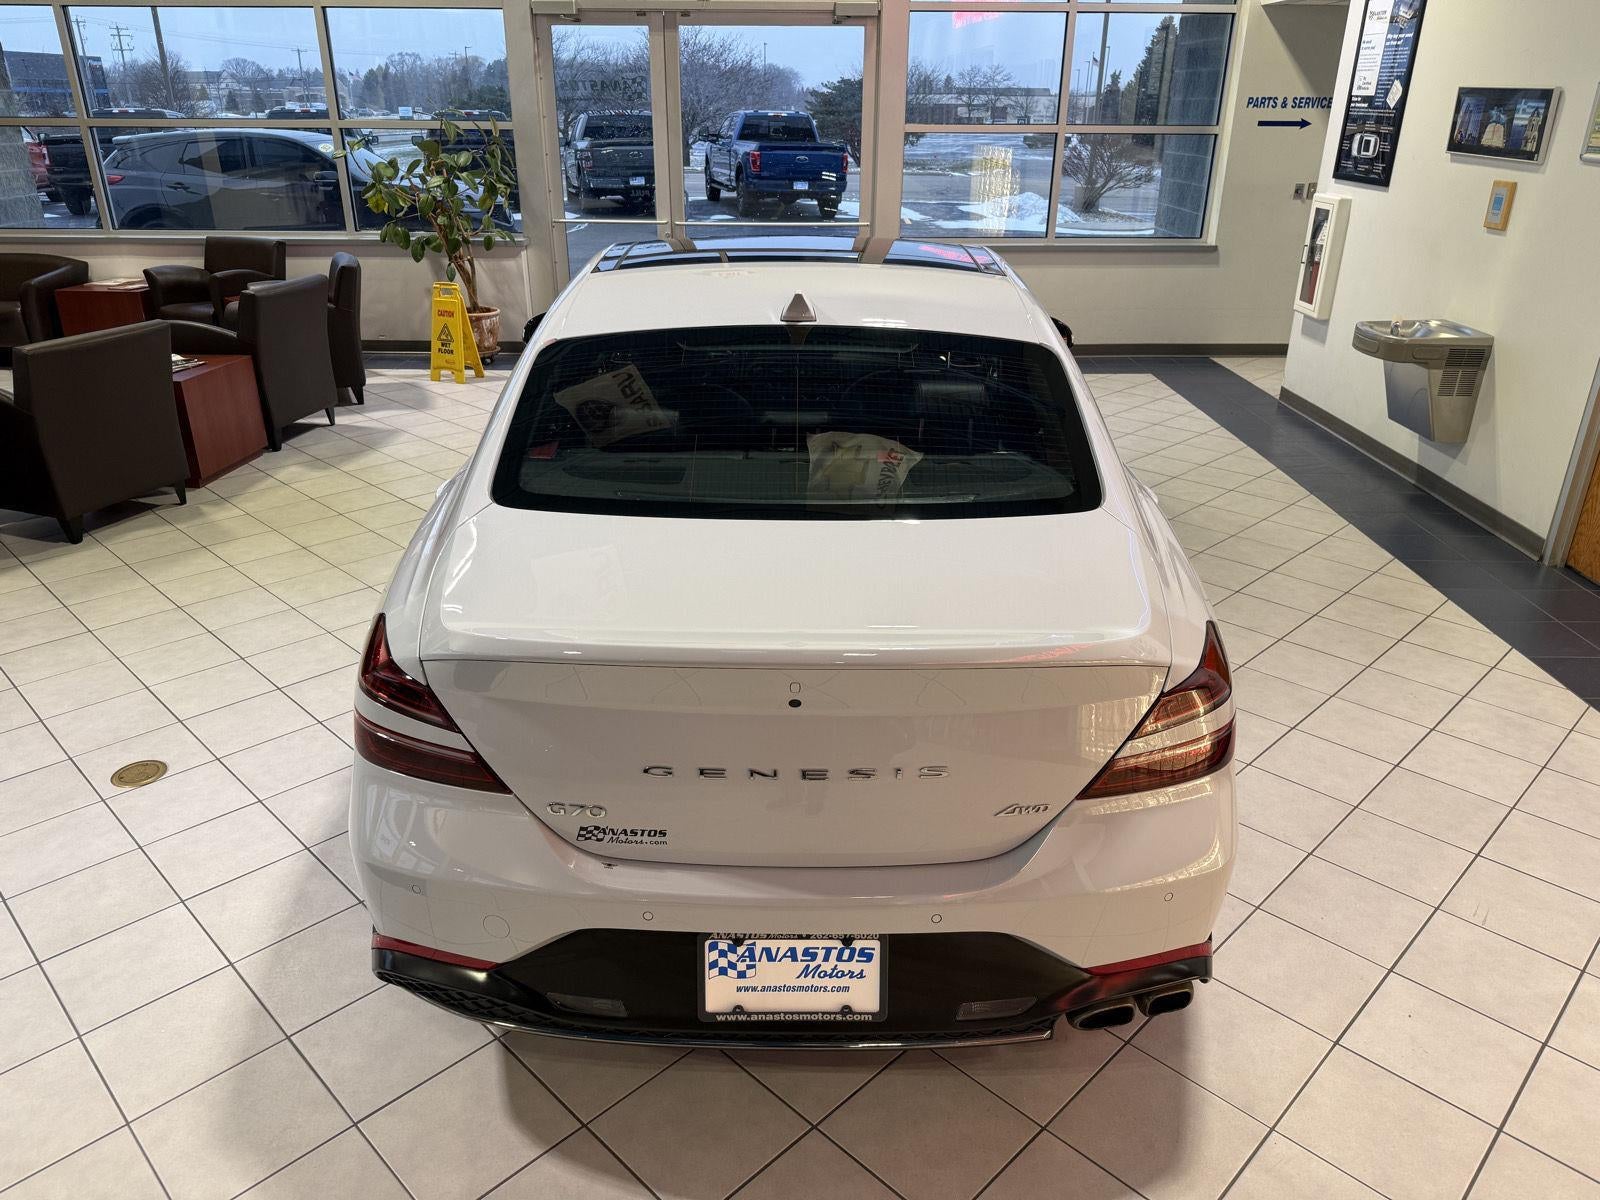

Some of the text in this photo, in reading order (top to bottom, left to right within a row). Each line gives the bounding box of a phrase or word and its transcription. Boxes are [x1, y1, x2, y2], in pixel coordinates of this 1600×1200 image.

[1246, 96, 1334, 109] PARTS & SERVICE
[437, 309, 454, 318] CAUTION
[642, 765, 950, 781] GENESIS
[546, 801, 607, 818] G70
[994, 803, 1051, 817] AWD
[597, 826, 668, 837] ANASTOS
[737, 941, 876, 963] ANASTOS
[796, 964, 867, 980] Motors
[736, 984, 851, 993] www.anastosmotors.com
[716, 1012, 873, 1022] www.anastosmotors.com
